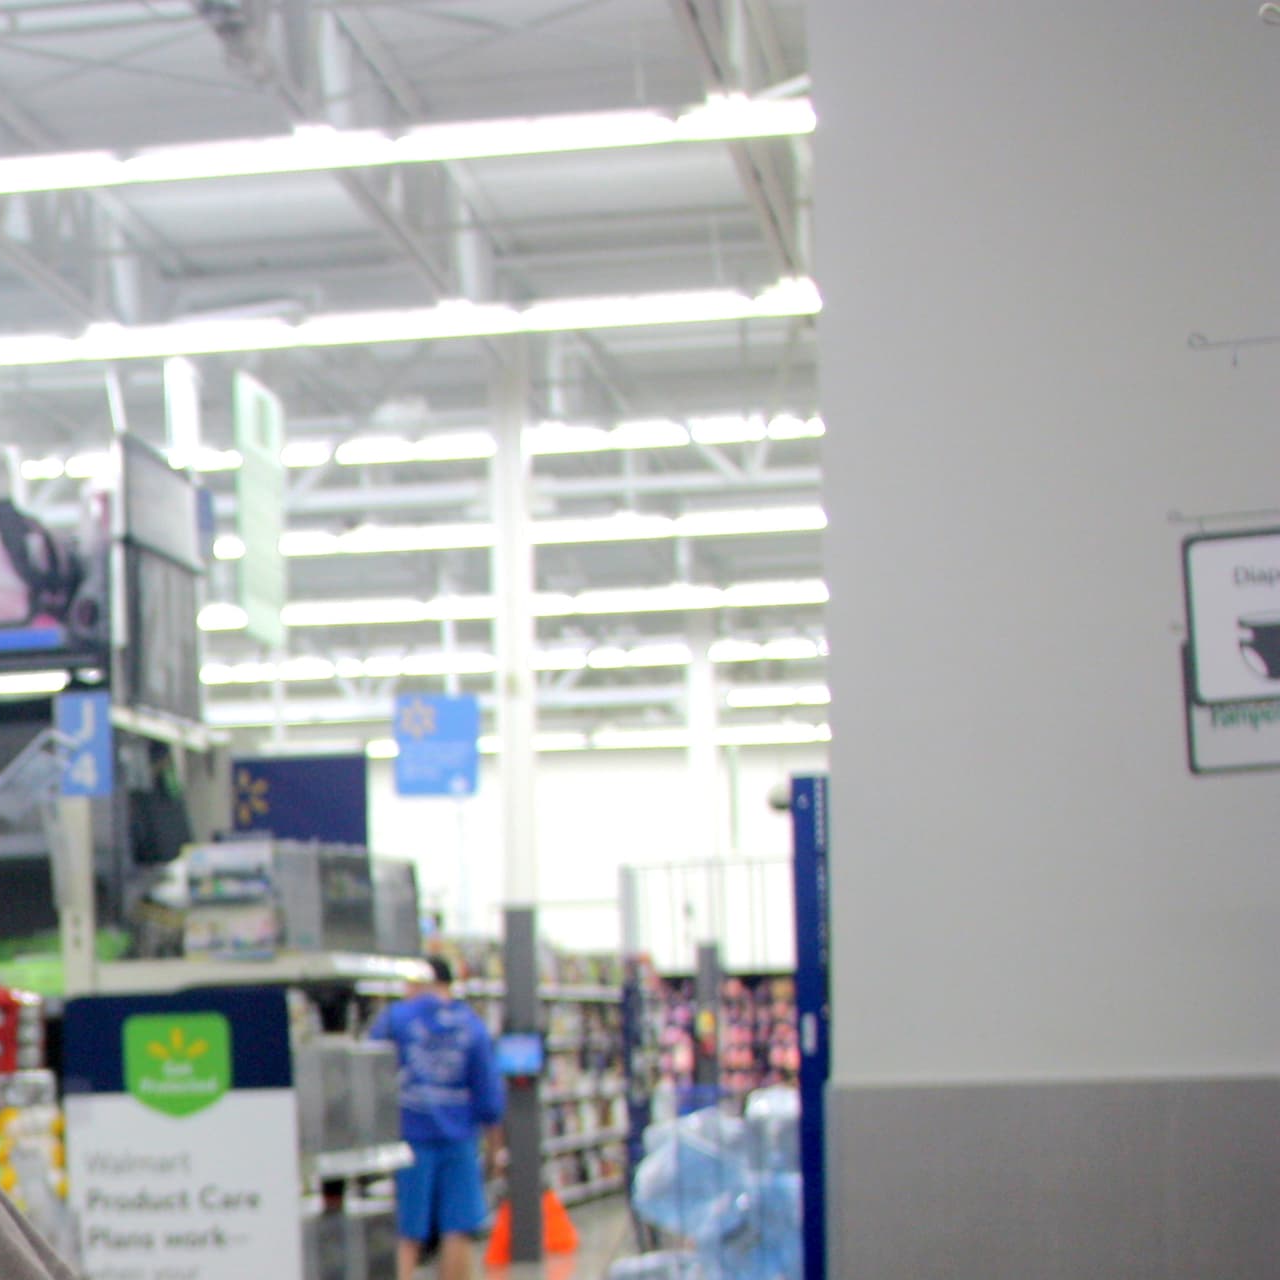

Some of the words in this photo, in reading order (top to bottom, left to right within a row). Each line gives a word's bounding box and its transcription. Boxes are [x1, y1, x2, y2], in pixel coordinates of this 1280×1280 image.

[86, 1151, 191, 1174] Walmart
[87, 1184, 188, 1210] Product
[198, 1183, 261, 1210] Care
[88, 1226, 154, 1249] Plans
